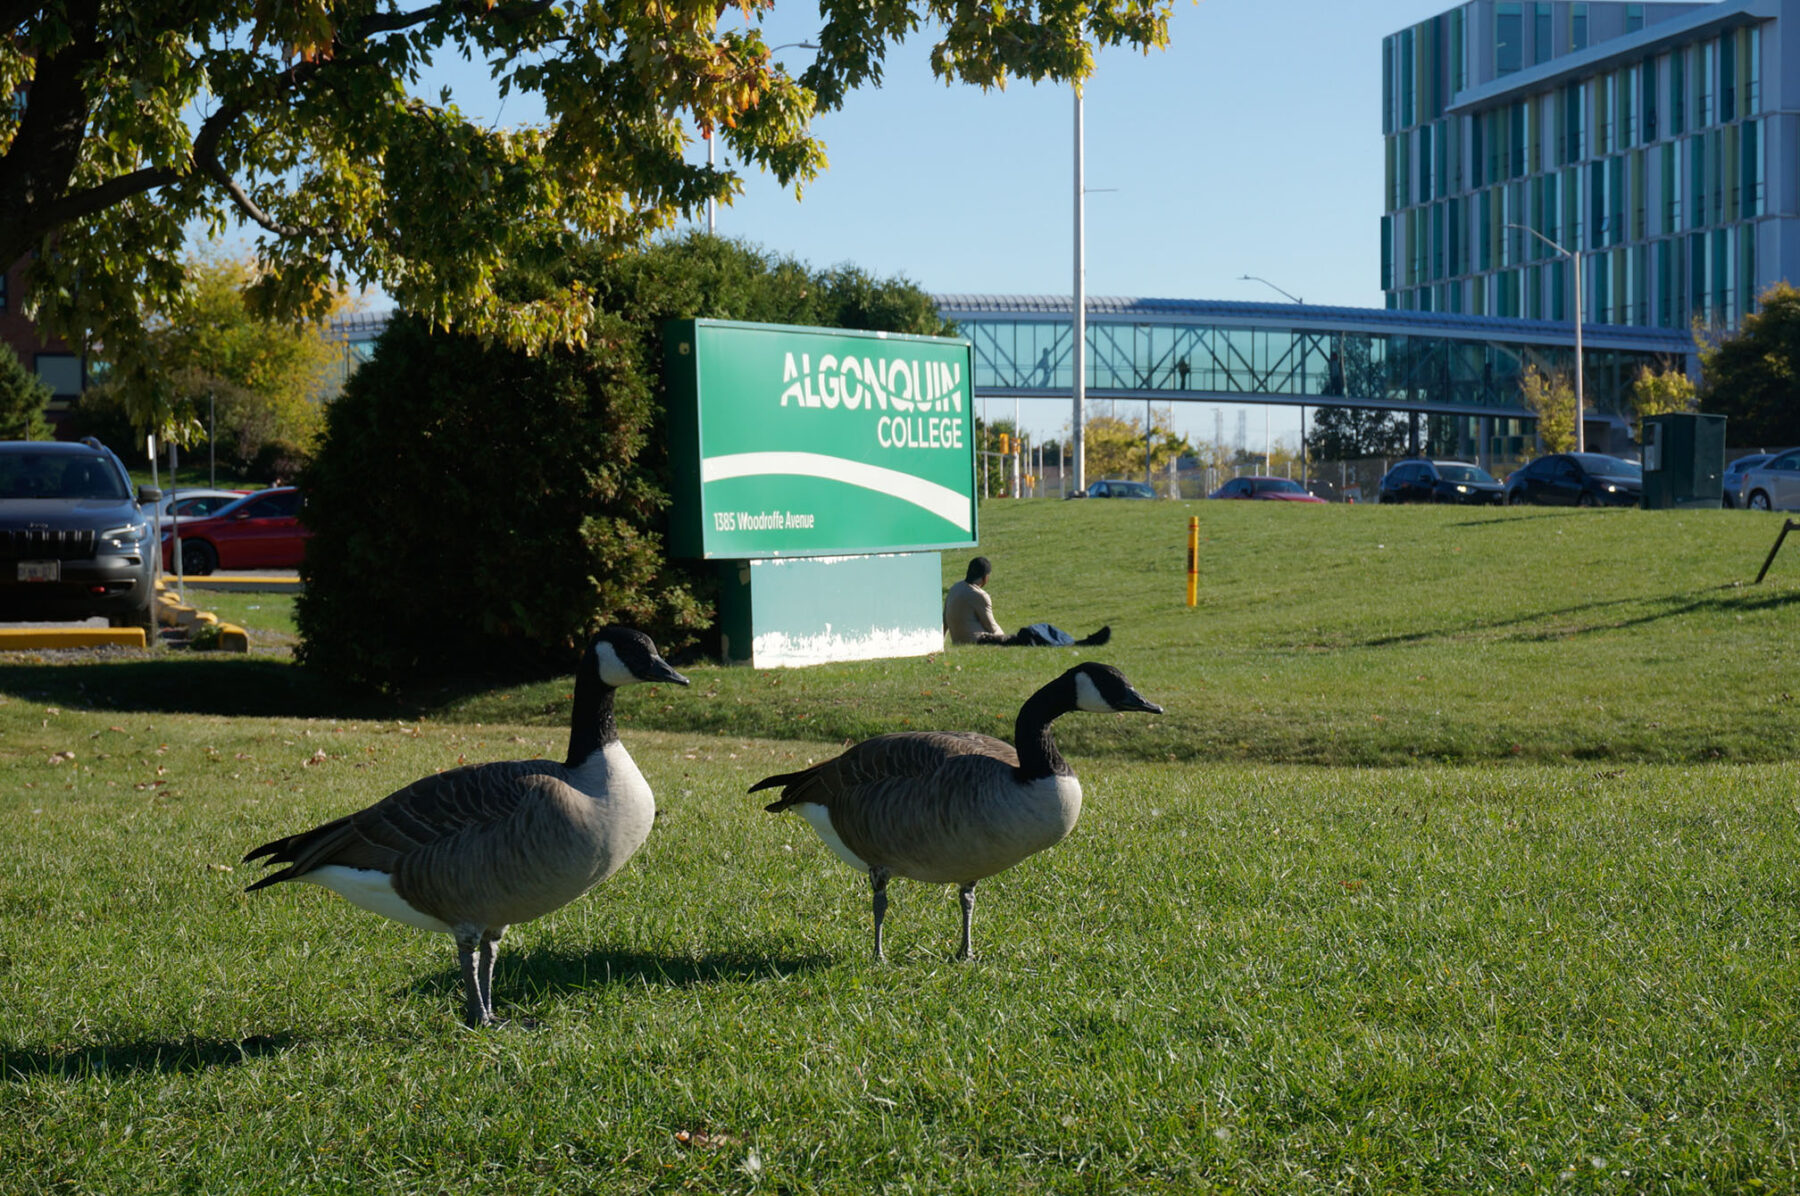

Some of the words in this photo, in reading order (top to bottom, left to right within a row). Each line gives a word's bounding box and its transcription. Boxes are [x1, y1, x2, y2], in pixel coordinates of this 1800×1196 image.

[780, 352, 962, 413] ALGONQUIN
[877, 416, 963, 448] COLLEGE
[713, 512, 735, 531] 1385
[737, 511, 783, 530] Woodroffe
[785, 511, 814, 529] Avenue
